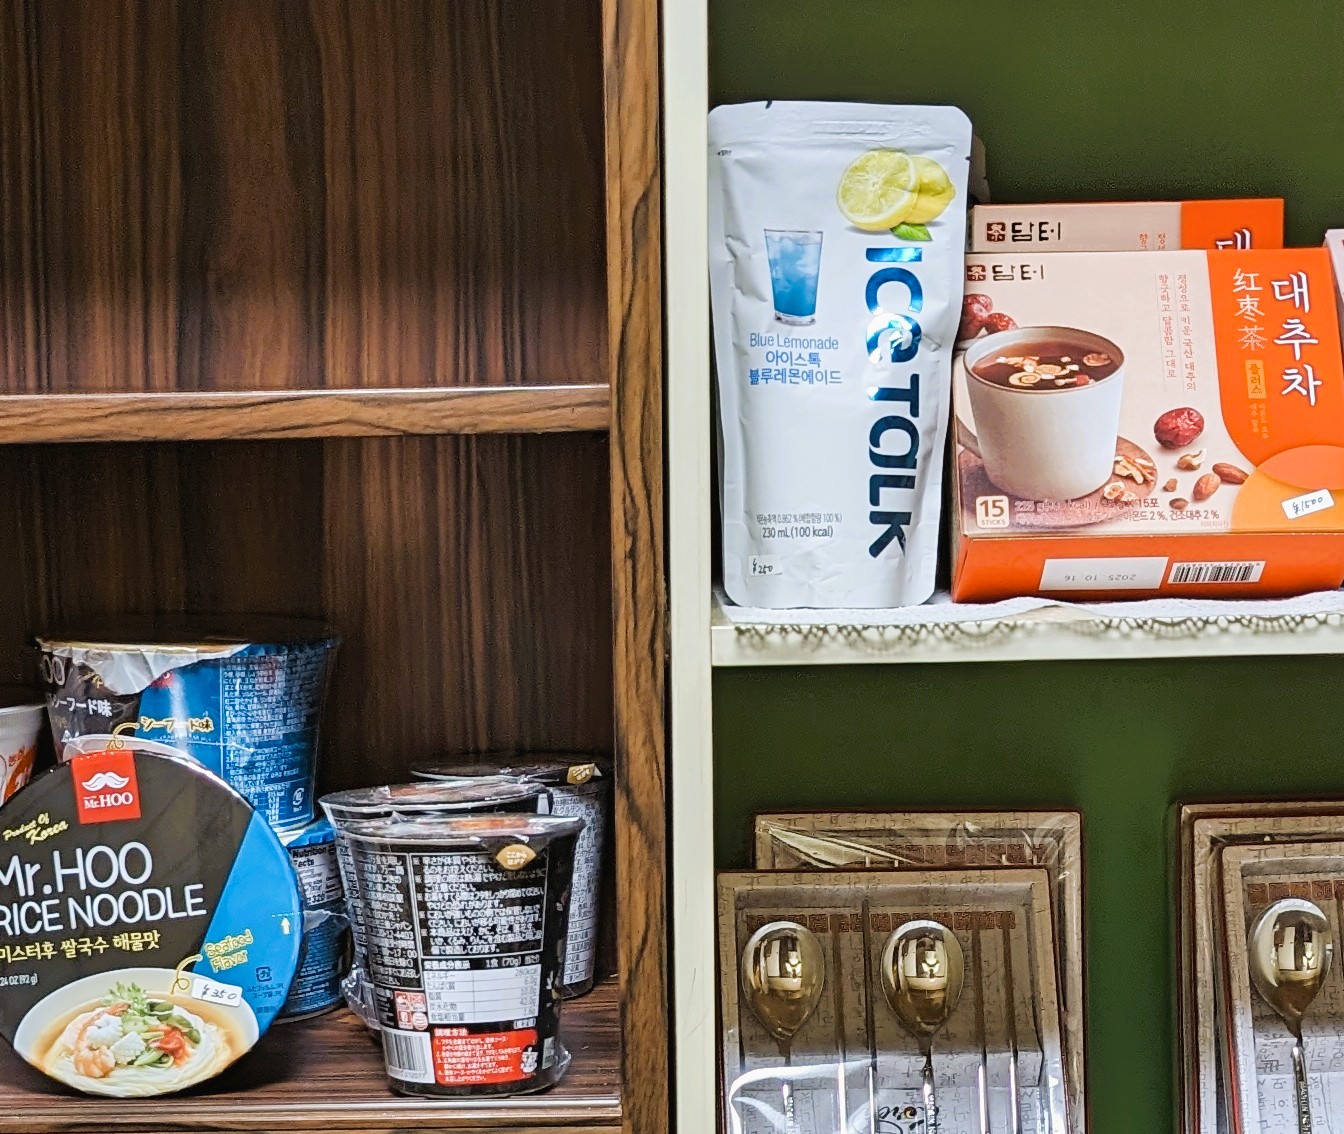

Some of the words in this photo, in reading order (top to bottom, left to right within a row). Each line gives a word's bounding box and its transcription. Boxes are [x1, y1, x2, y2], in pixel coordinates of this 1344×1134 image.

[1232, 268, 1268, 351] 红枣茶
[750, 333, 775, 347] Blue
[777, 335, 839, 350] Lemonade
[1271, 271, 1323, 407] 대추차
[749, 368, 843, 385] 블루레몬에이드
[979, 499, 1004, 518] 15
[762, 526, 776, 538] 230
[812, 525, 834, 538] kcal)
[1108, 573, 1137, 582] 2025
[83, 791, 134, 810] Mr.HOO
[3, 819, 38, 841] Product
[26, 820, 69, 845] Korea
[69, 883, 207, 931] NOODLE
[60, 935, 110, 959] 쌀국수
[112, 930, 162, 952] 해물맛
[206, 928, 254, 957] Seafood
[210, 950, 249, 973] Flavor
